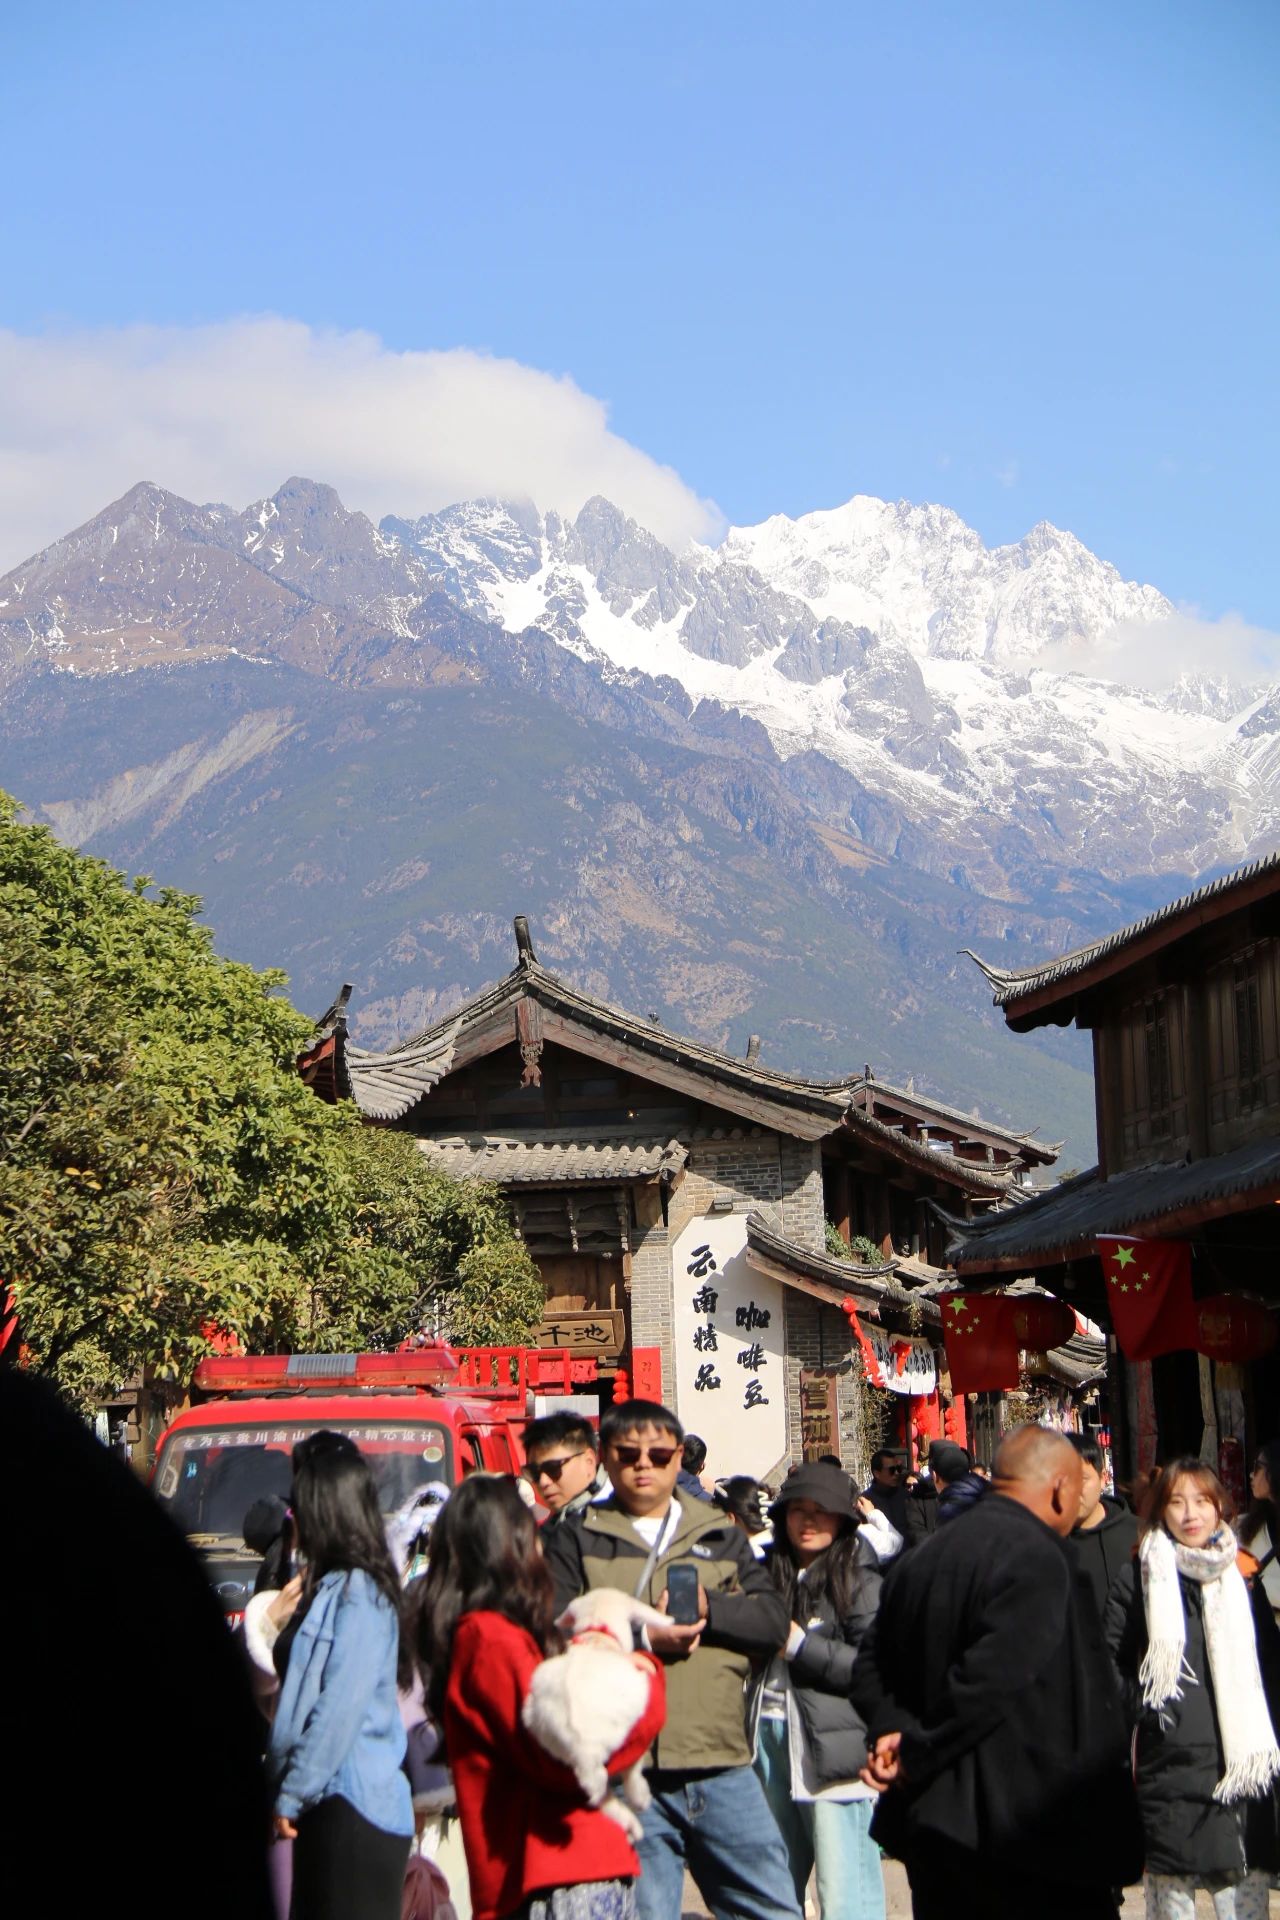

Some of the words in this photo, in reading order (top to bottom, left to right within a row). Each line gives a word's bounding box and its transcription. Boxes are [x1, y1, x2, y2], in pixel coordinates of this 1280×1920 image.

[687, 1244, 721, 1392] 云南精品
[736, 1301, 771, 1410] 咖啡豆
